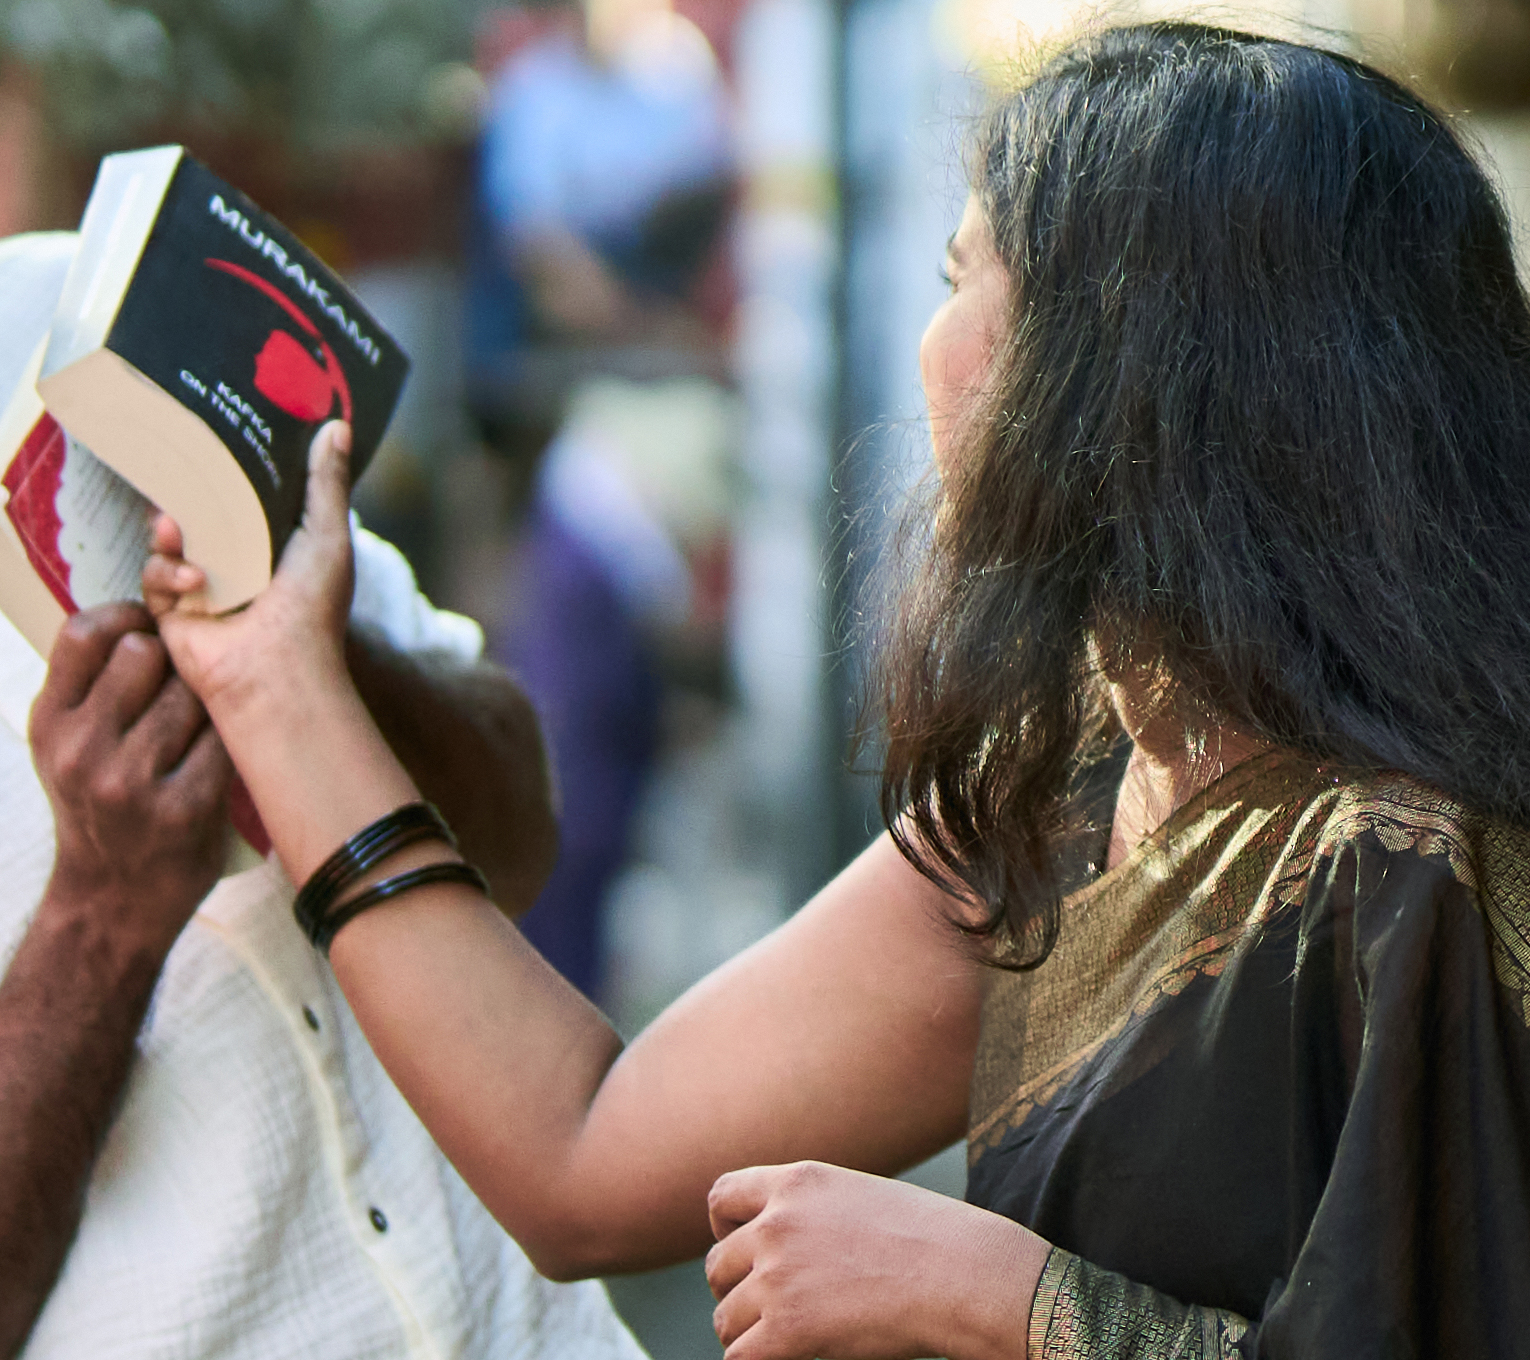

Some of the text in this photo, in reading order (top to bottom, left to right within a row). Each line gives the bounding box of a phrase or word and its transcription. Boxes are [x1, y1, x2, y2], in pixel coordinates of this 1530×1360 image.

[209, 194, 380, 366] MURAKAMI
[179, 370, 207, 397] ON
[211, 391, 240, 427] THE
[217, 381, 272, 444] KAFKA
